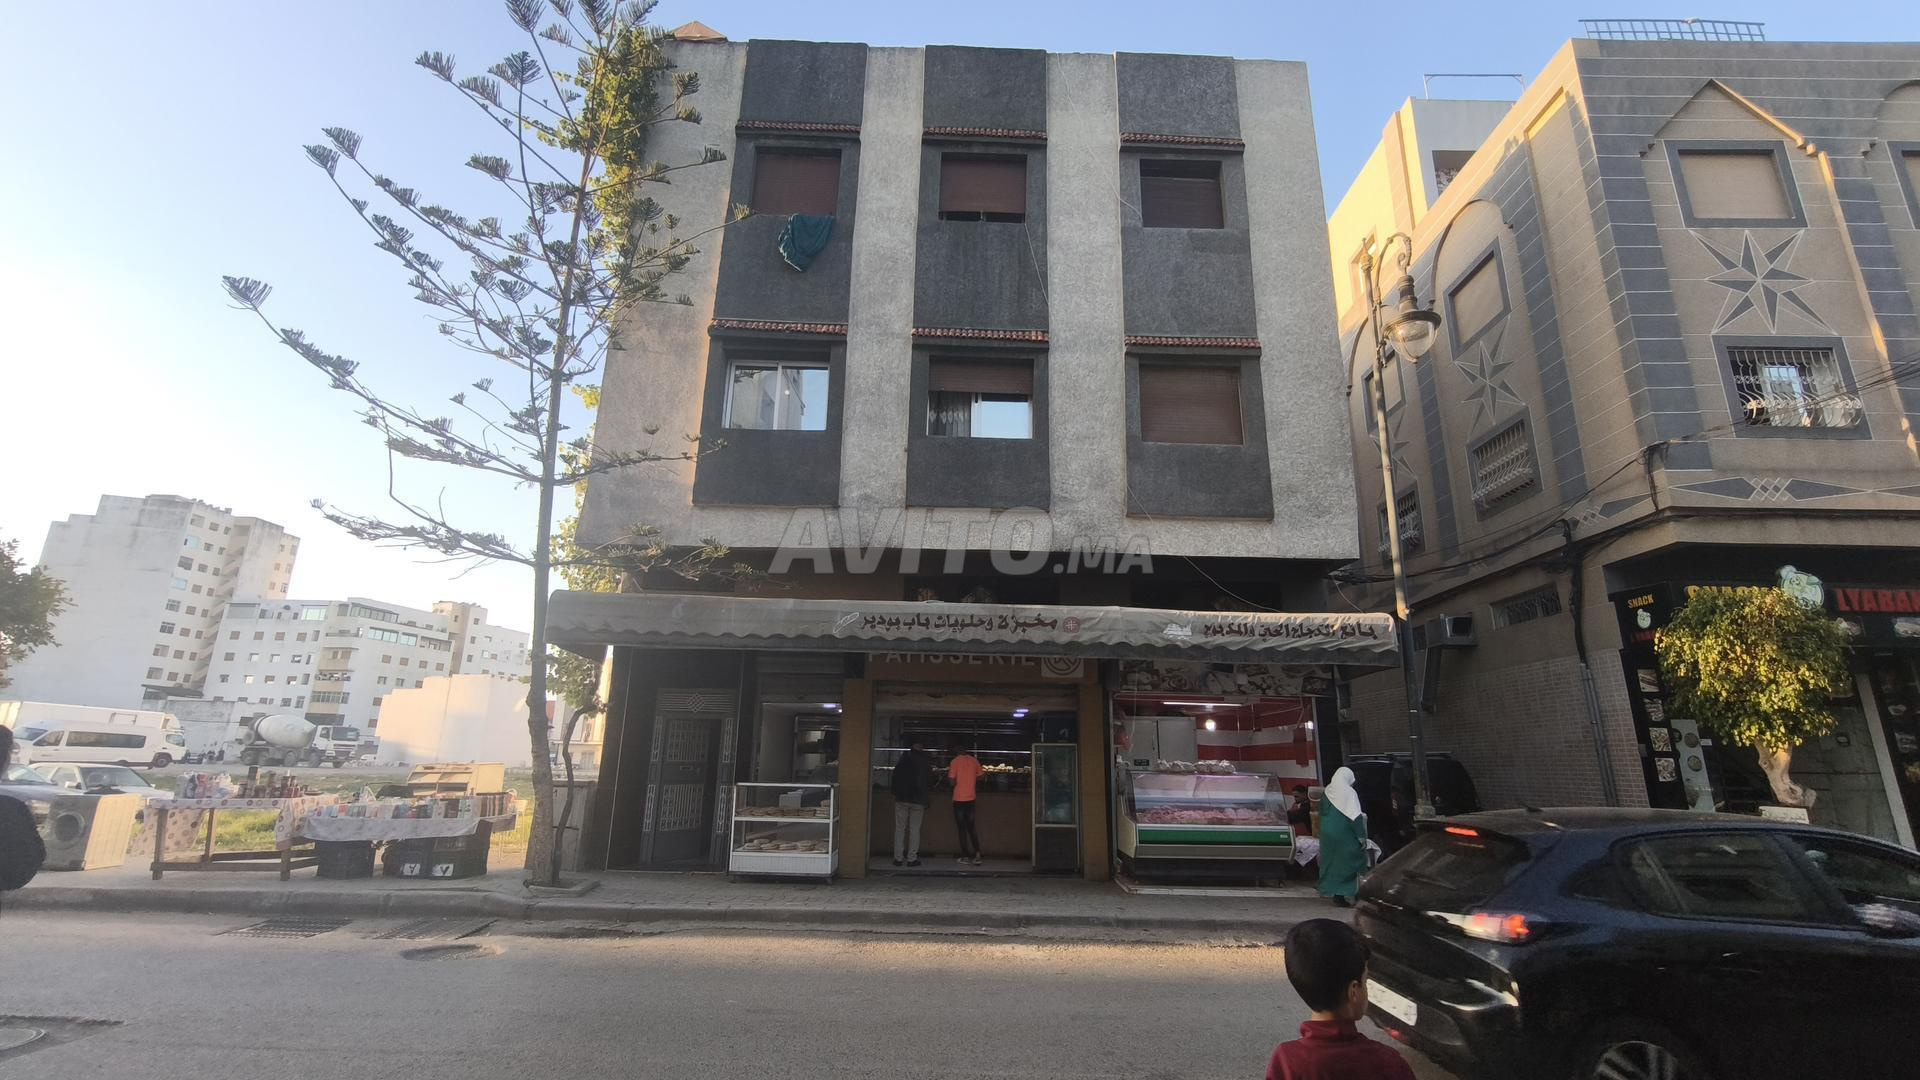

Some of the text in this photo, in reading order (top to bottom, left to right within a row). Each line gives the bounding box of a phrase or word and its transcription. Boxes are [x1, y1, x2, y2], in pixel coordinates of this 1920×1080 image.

[1627, 594, 1654, 608] SNACK
[902, 612, 931, 631] باب
[934, 613, 994, 634] وحلويات
[997, 612, 1058, 634] مخبزة
[1291, 622, 1337, 639] الدجاج
